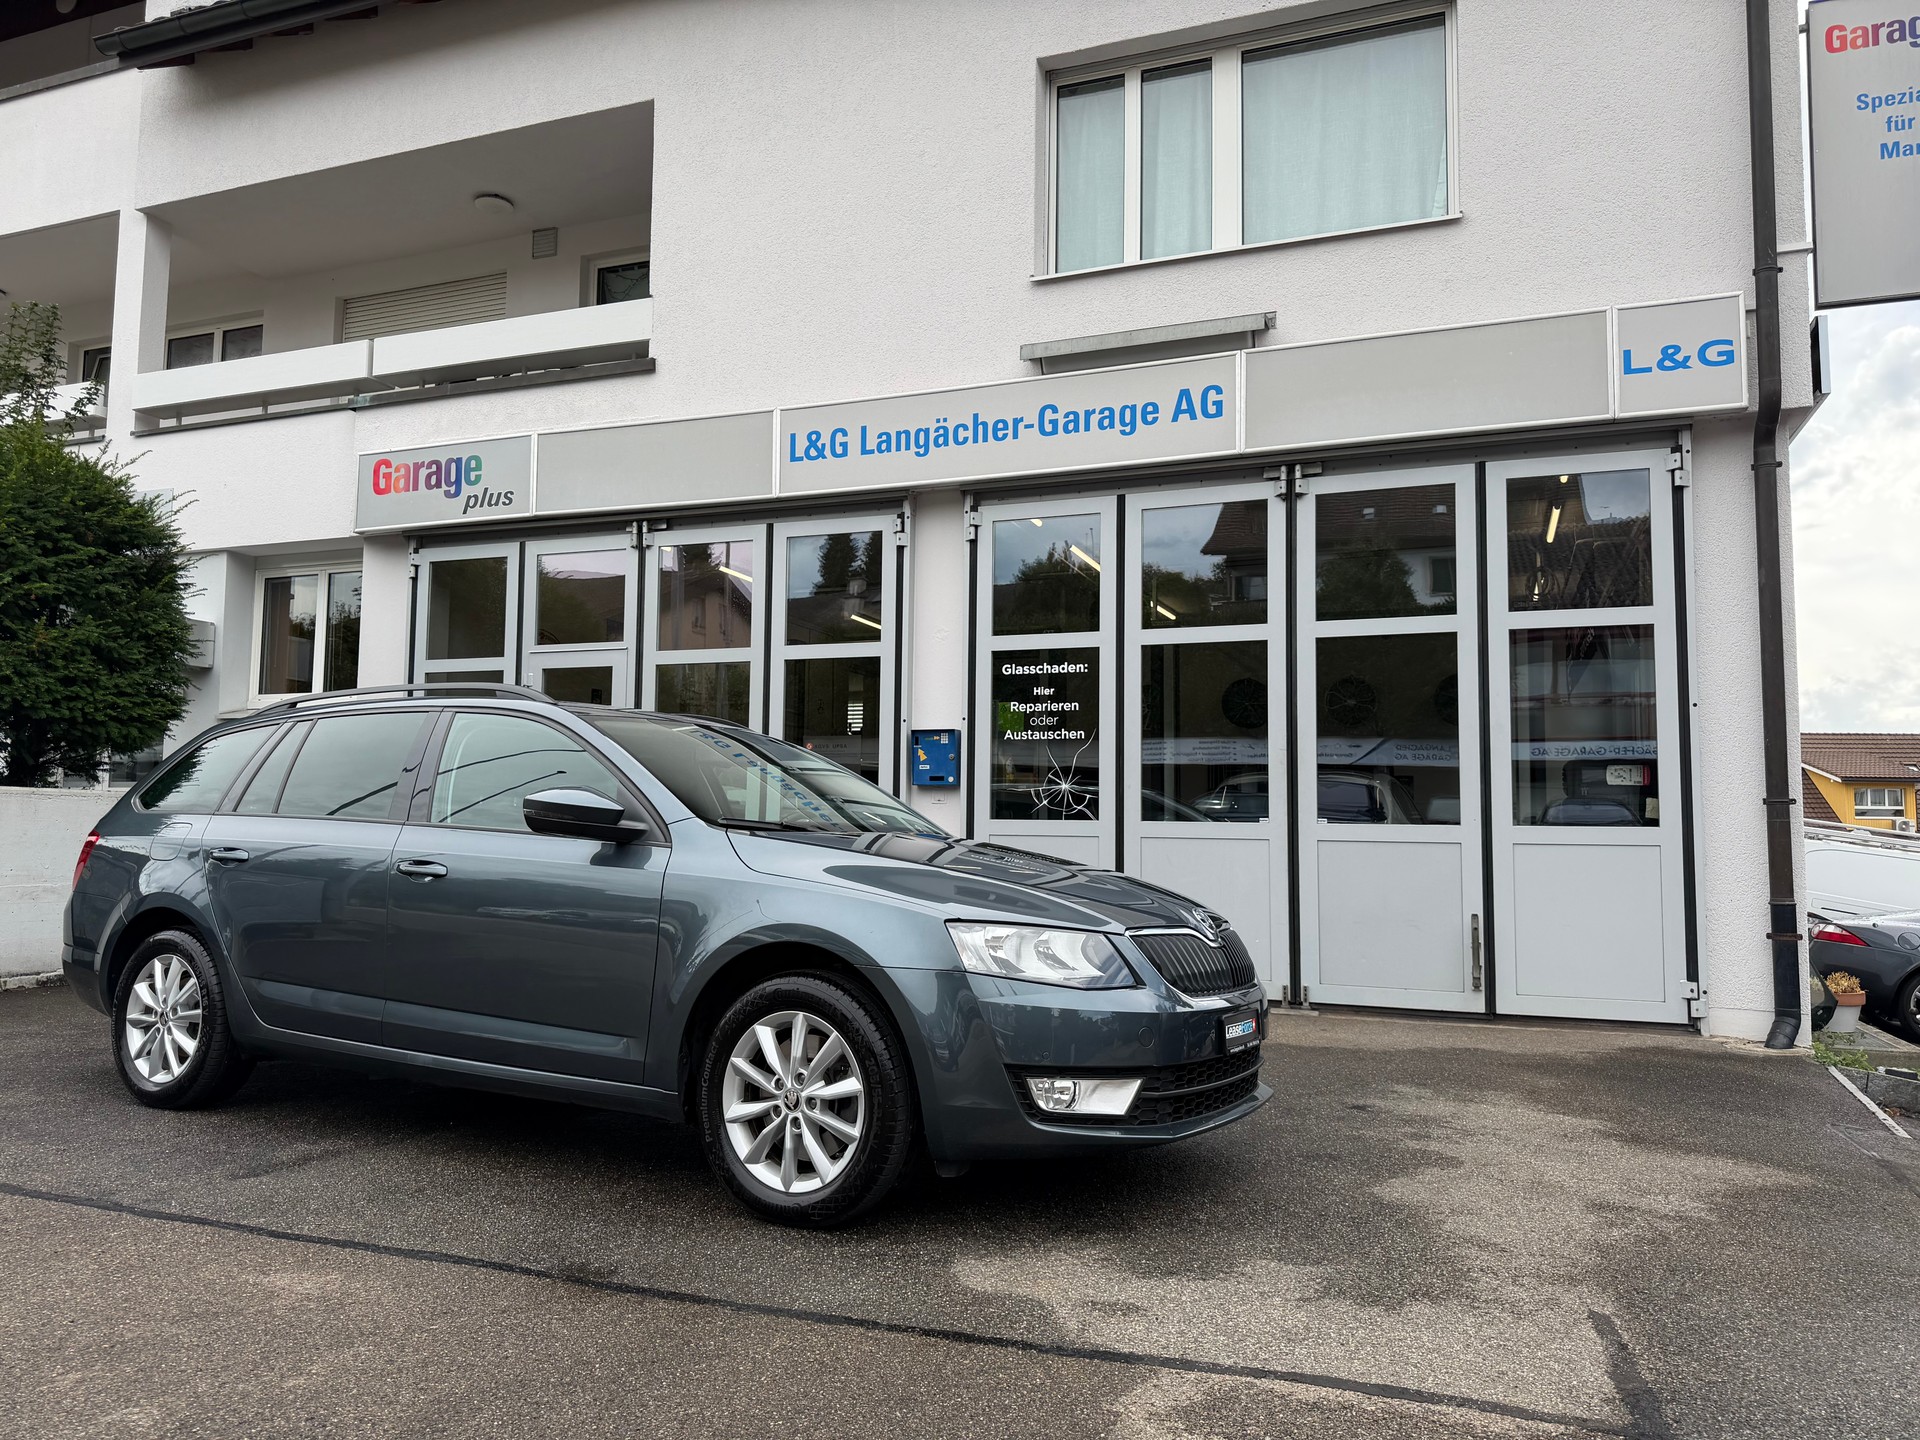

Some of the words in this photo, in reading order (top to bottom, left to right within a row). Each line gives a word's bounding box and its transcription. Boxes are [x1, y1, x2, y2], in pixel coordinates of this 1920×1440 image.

[1885, 114, 1916, 133] für
[1622, 338, 1735, 375] L&G
[788, 427, 849, 463] L&G
[860, 400, 1160, 458] Langächer-Garage
[1170, 384, 1225, 423] AG
[372, 454, 483, 499] Garage
[462, 487, 515, 515] plus
[1001, 662, 1089, 675] Glasschaden:
[1033, 686, 1055, 696] Hier
[1010, 701, 1080, 714] Reparieren
[1029, 714, 1059, 726] oder
[1003, 728, 1085, 740] Austauschen
